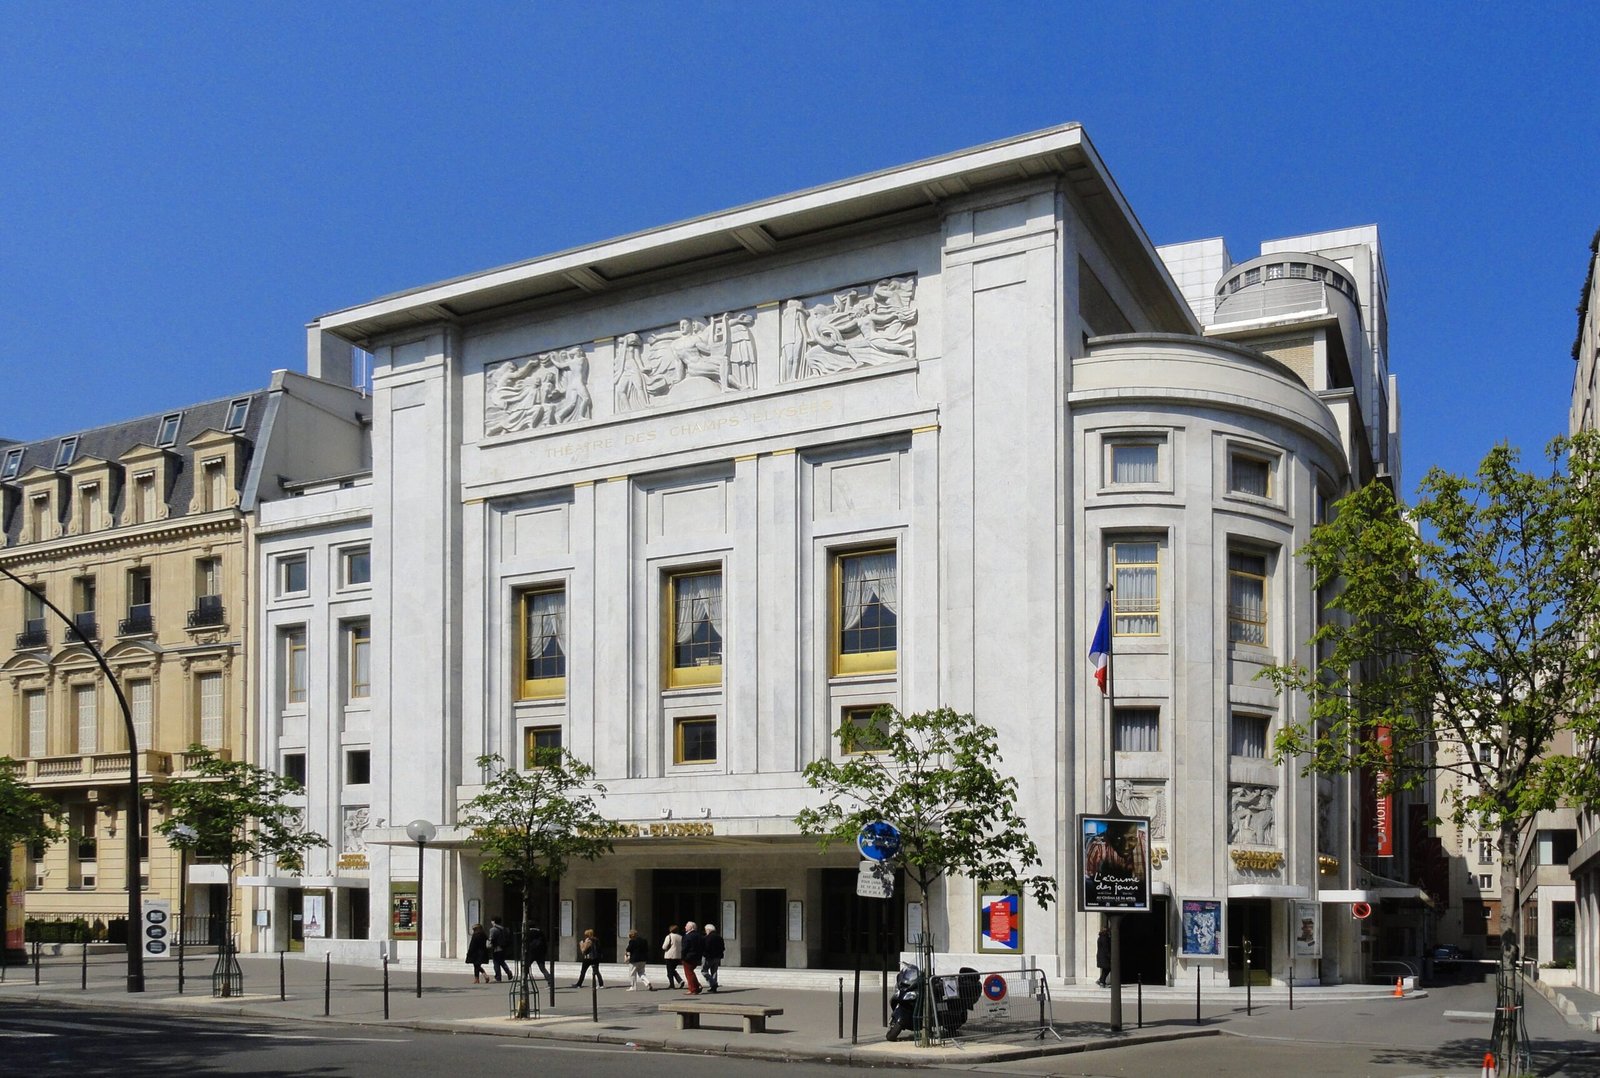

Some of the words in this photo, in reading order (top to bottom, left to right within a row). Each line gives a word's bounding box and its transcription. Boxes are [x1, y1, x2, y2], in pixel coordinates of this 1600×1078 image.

[624, 430, 658, 446] DES
[1236, 859, 1278, 870] STUDIO
[1096, 882, 1112, 890] des
[1115, 882, 1139, 895] jours
